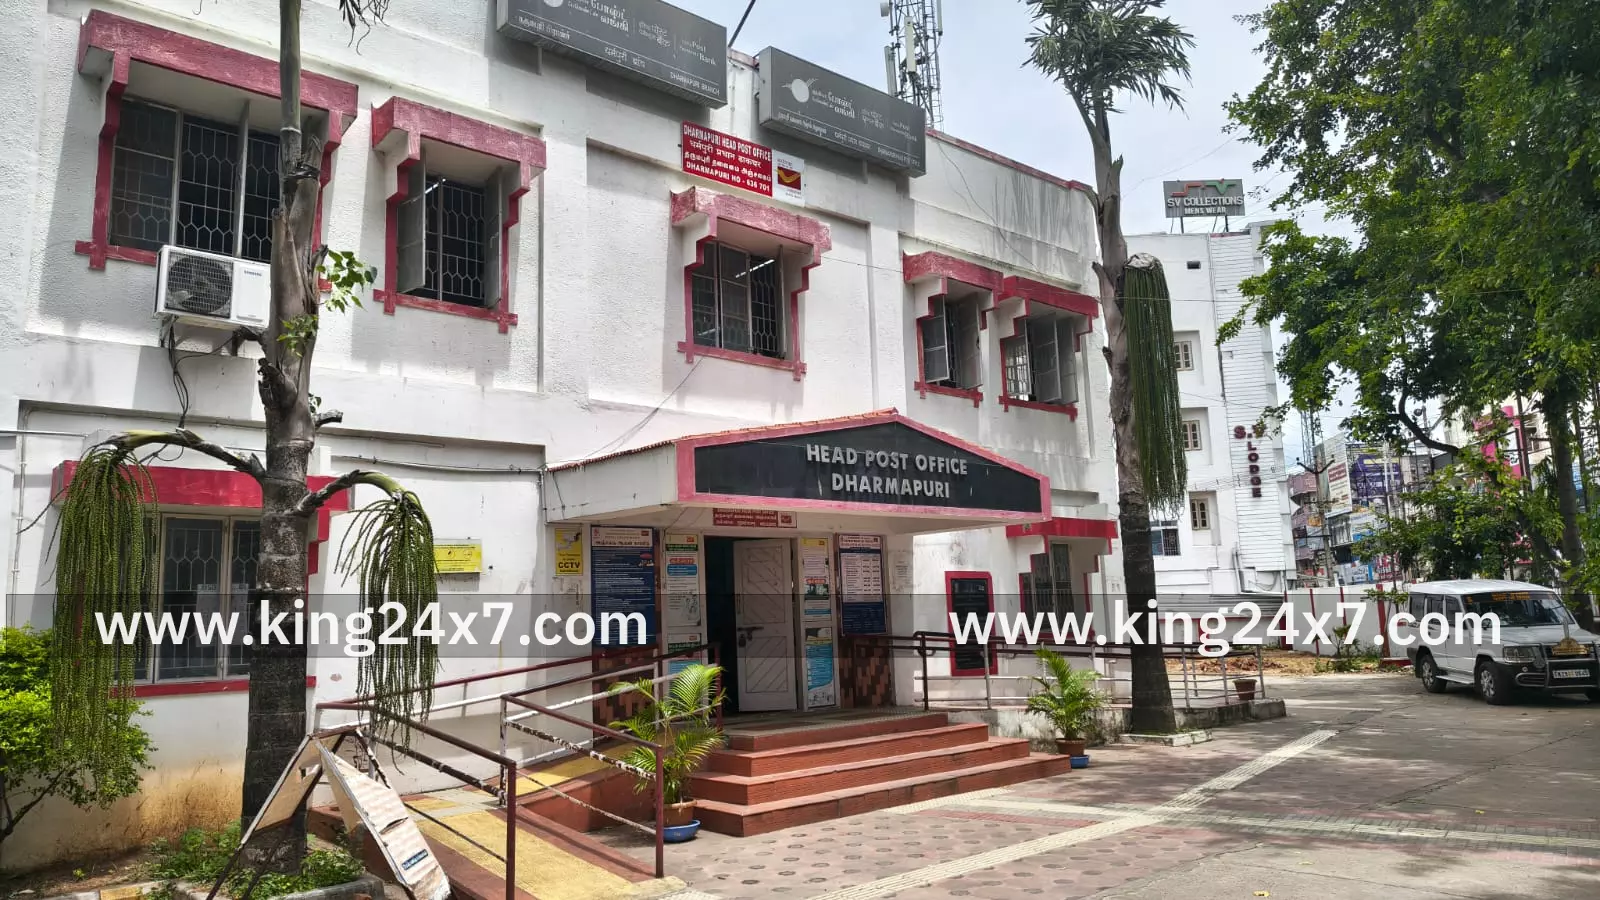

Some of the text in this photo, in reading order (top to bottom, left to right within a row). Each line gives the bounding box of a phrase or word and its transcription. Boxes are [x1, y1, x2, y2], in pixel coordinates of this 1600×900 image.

[684, 124, 772, 162] DHARMAPURI HEAD POST OFFICE
[686, 161, 730, 180] DHARMAPURI
[731, 174, 741, 183] HO
[746, 179, 757, 188] 636
[759, 182, 770, 192] 701
[1168, 196, 1244, 208] SV COLLECTIONS
[1205, 206, 1226, 214] WEAR
[806, 444, 968, 476] HEAD POST OFFICE
[831, 473, 950, 499] DHARMAPURI
[558, 561, 580, 569] CCTV
